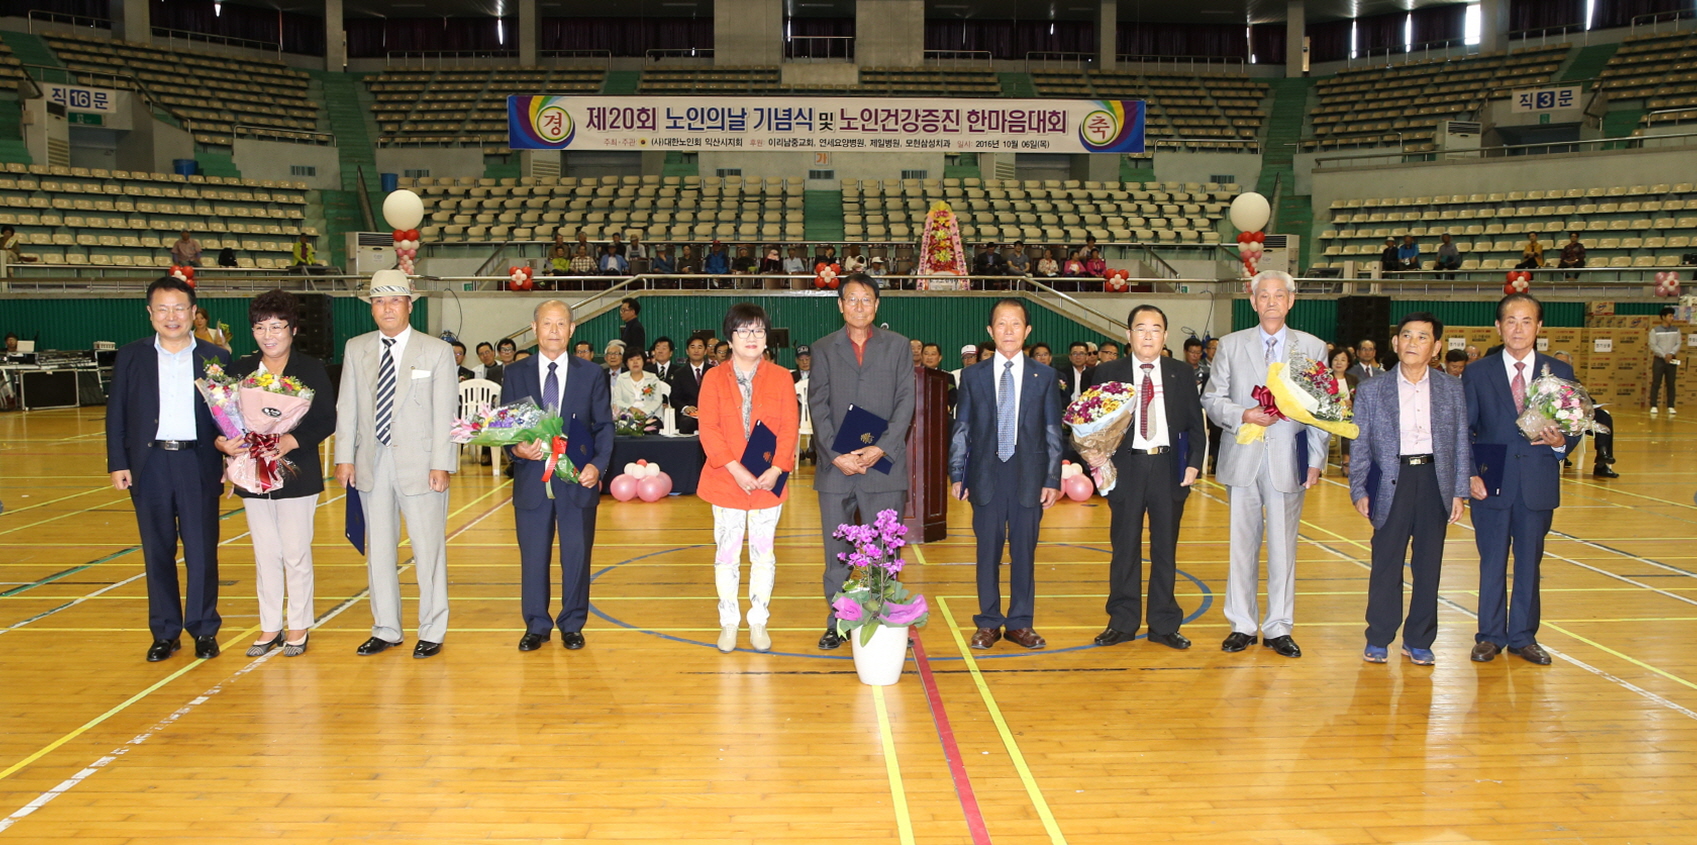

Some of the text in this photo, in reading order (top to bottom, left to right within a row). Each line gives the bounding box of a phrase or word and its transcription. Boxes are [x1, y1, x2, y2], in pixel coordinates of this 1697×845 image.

[544, 112, 562, 136] 경
[586, 106, 1066, 134] 제20회 노인의날 기념식 및 노인건강증진 한마음대회
[1088, 116, 1110, 140] 축
[651, 138, 702, 146] (사)대한노인회
[704, 138, 742, 147] 익산시지회
[957, 140, 973, 148] 일시:
[976, 140, 1000, 148] 2016년
[1003, 140, 1018, 149] 10월
[1022, 140, 1050, 149] 06일(목)
[816, 153, 828, 164] 가
